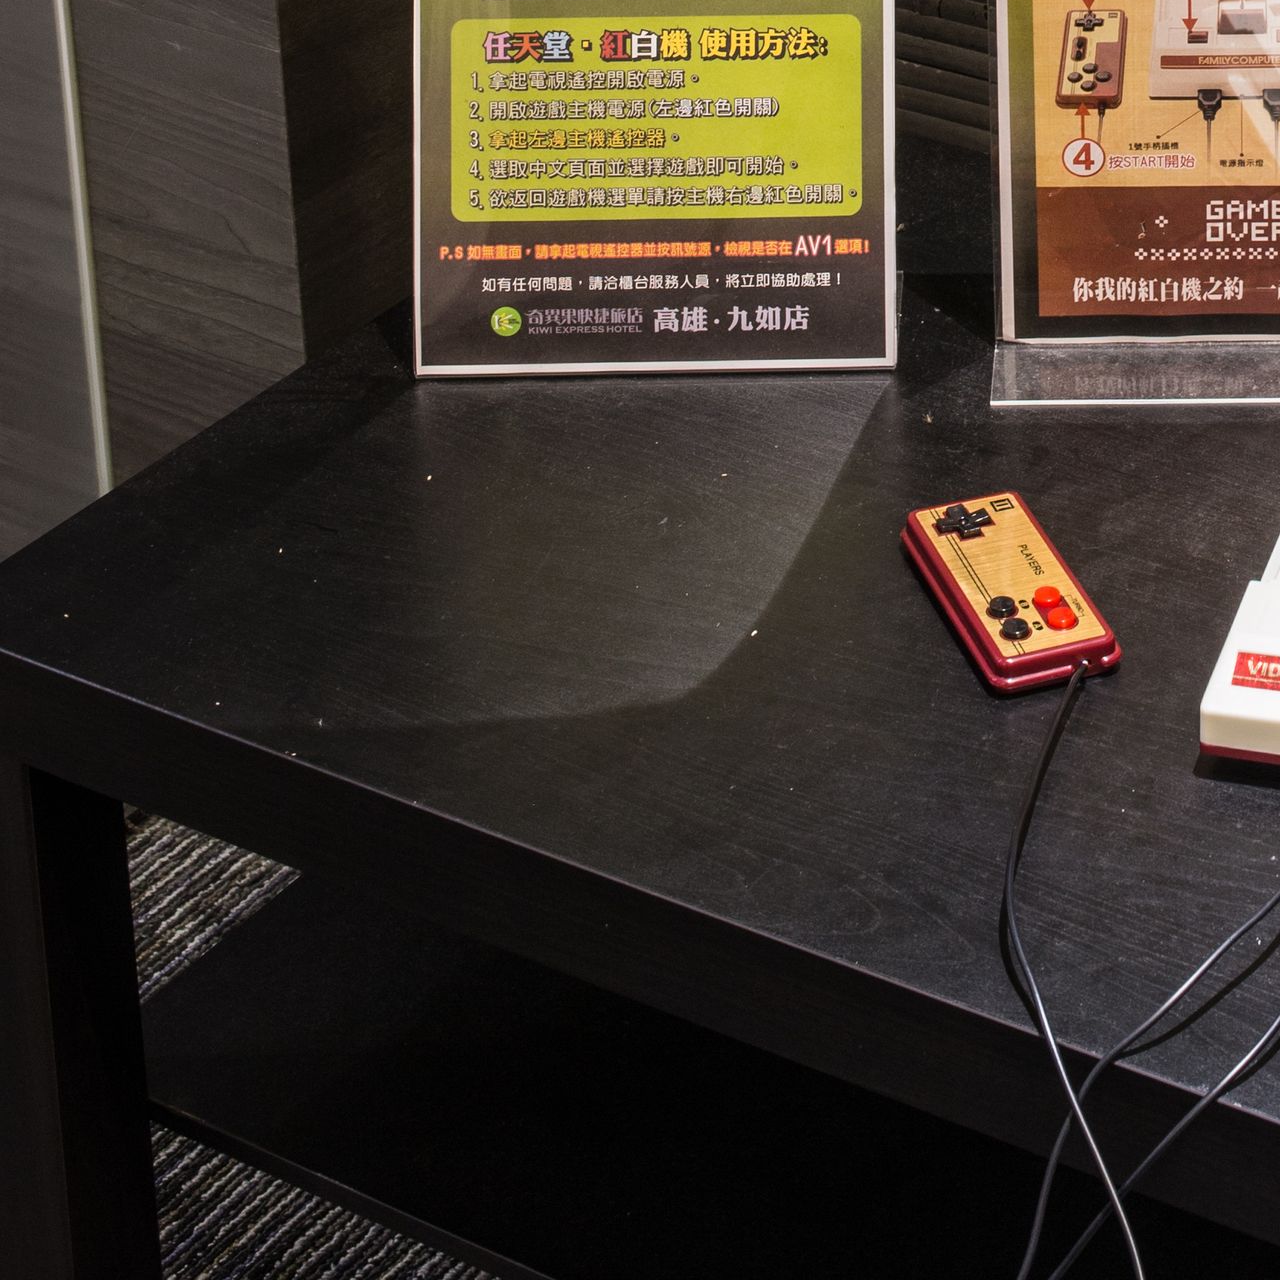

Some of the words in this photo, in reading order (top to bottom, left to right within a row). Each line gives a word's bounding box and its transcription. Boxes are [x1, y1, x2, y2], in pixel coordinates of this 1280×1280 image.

[1108, 154, 1196, 169] 按START開始
[1072, 276, 1244, 303] 你我的紅白機之約
[528, 326, 553, 335] KIWI
[555, 325, 605, 334] EXPRESS
[606, 324, 643, 334] HOTEL
[1017, 544, 1045, 577] PLAYERS
